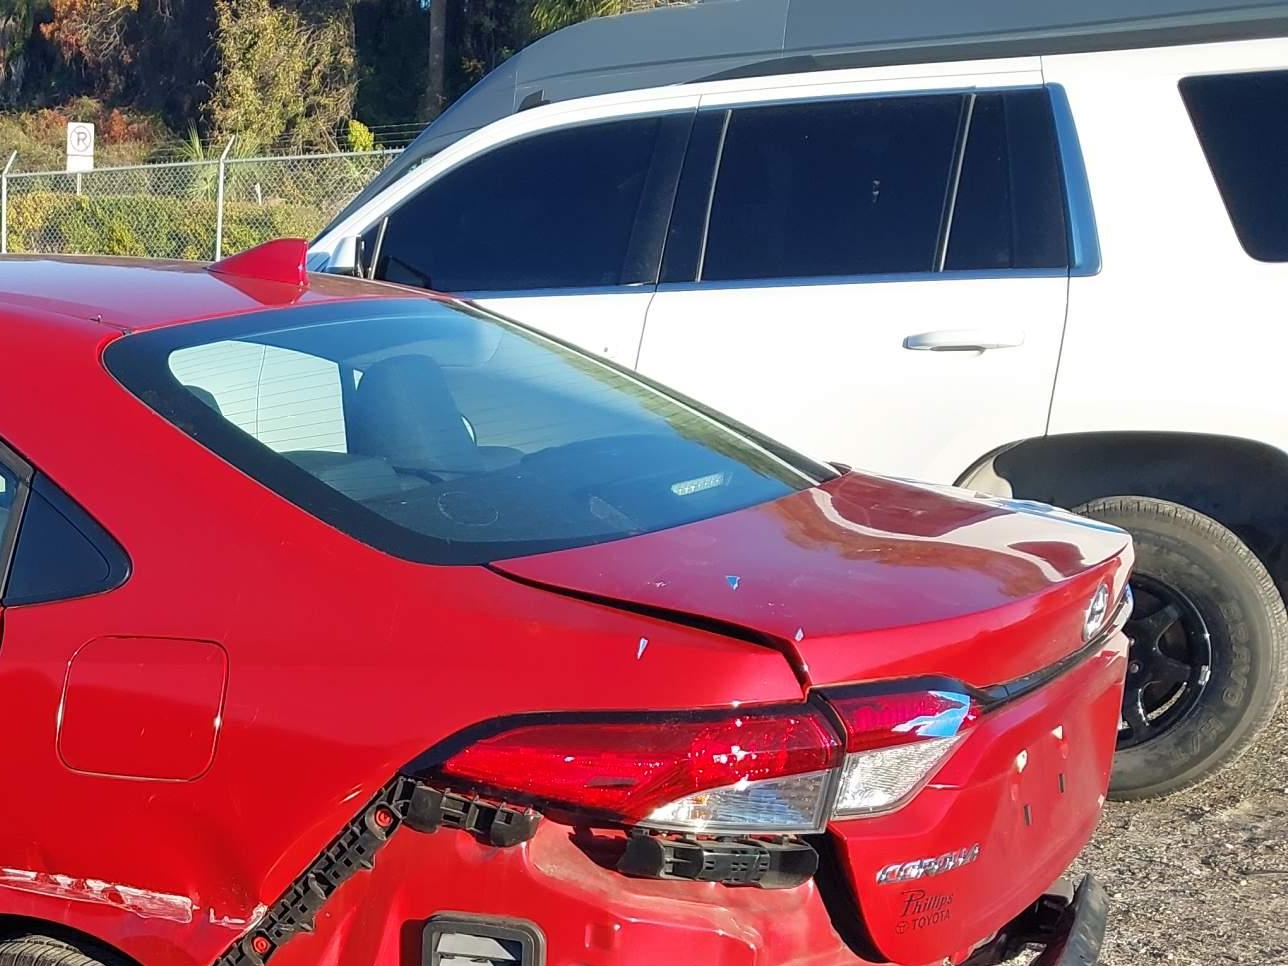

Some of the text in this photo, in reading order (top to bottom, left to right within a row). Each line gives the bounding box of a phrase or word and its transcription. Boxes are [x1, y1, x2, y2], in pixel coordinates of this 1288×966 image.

[875, 842, 980, 886] COROLLA
[900, 889, 954, 917] Phillips
[912, 909, 952, 930] TOYOTA
